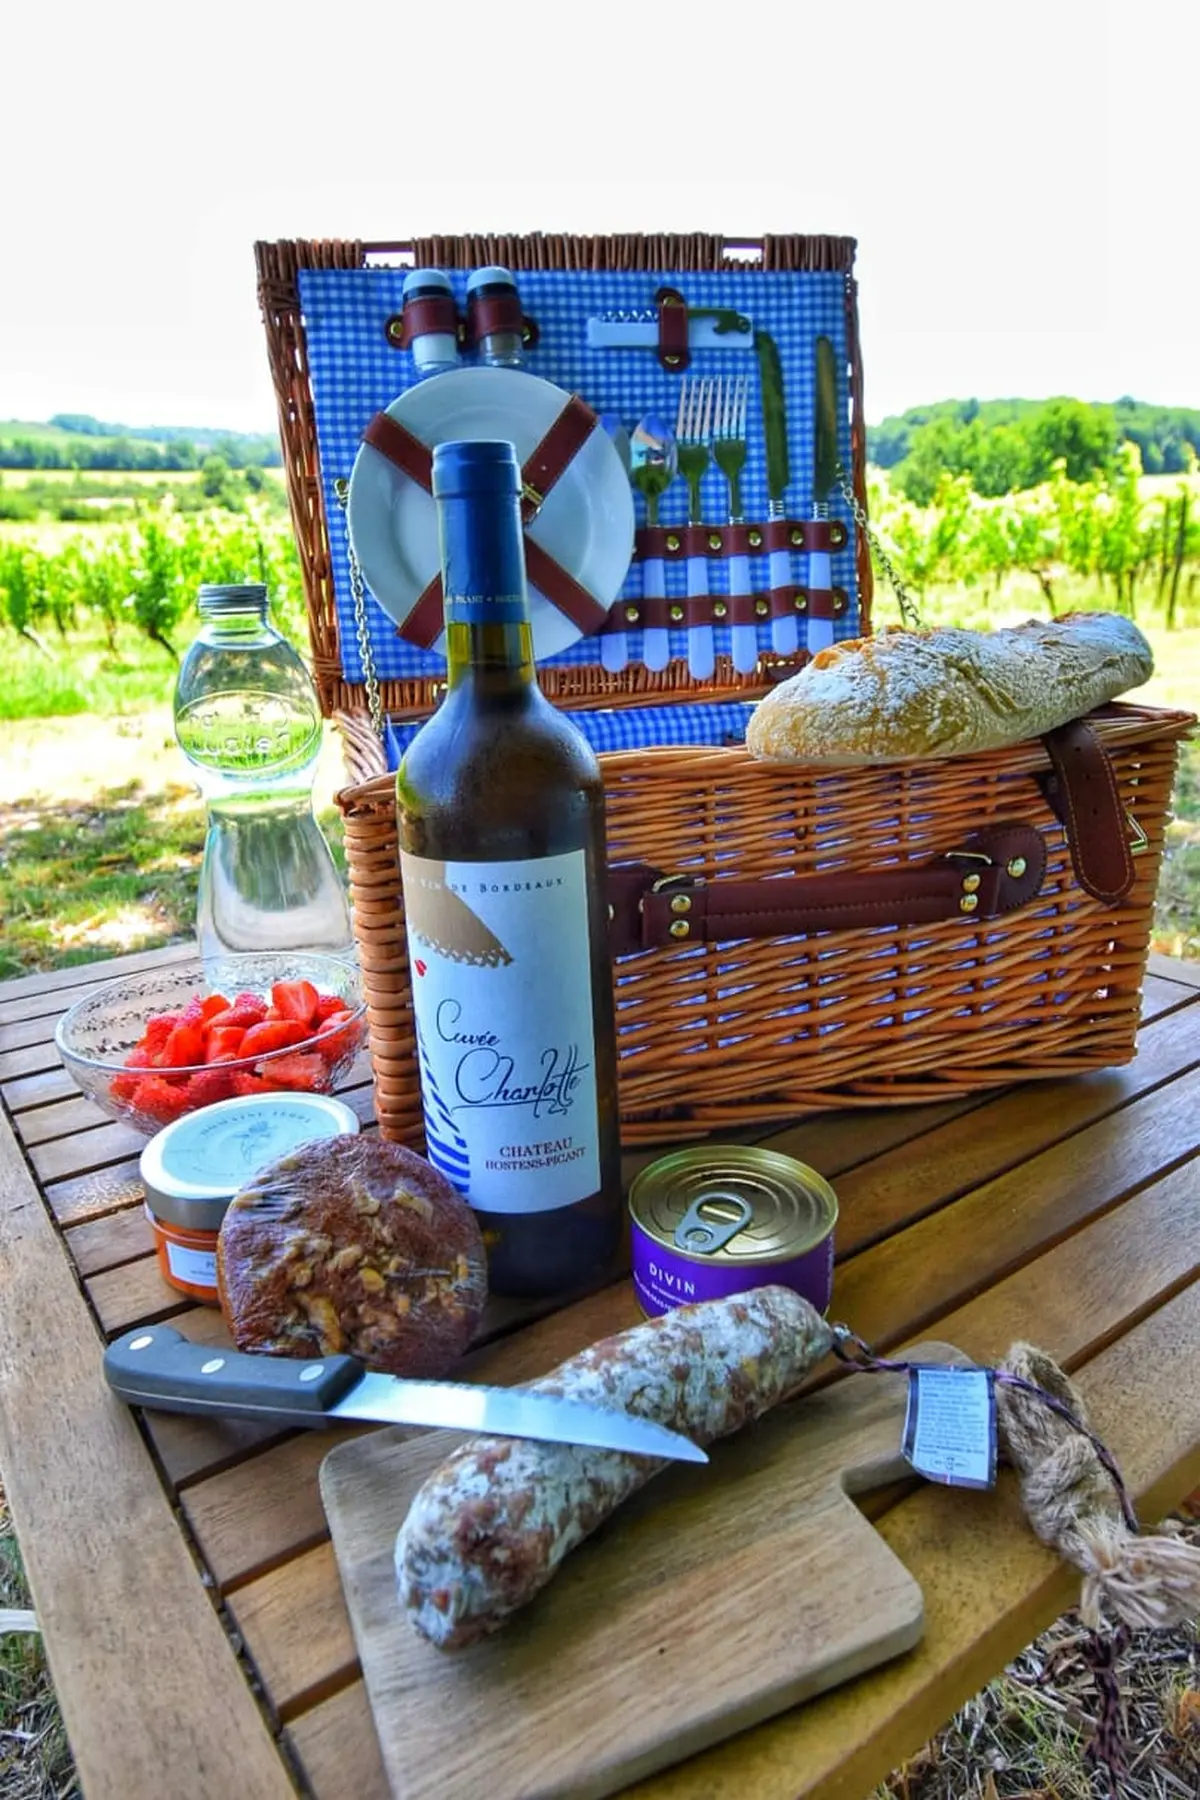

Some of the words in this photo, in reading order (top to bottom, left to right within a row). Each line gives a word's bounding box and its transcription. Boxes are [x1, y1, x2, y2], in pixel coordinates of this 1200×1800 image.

[479, 877, 564, 894] BORDEAUX
[436, 998, 500, 1047] Cuvée
[451, 1043, 589, 1119] Charlotte
[499, 1137, 573, 1159] CHATEAU
[649, 1261, 695, 1297] DIVIN
